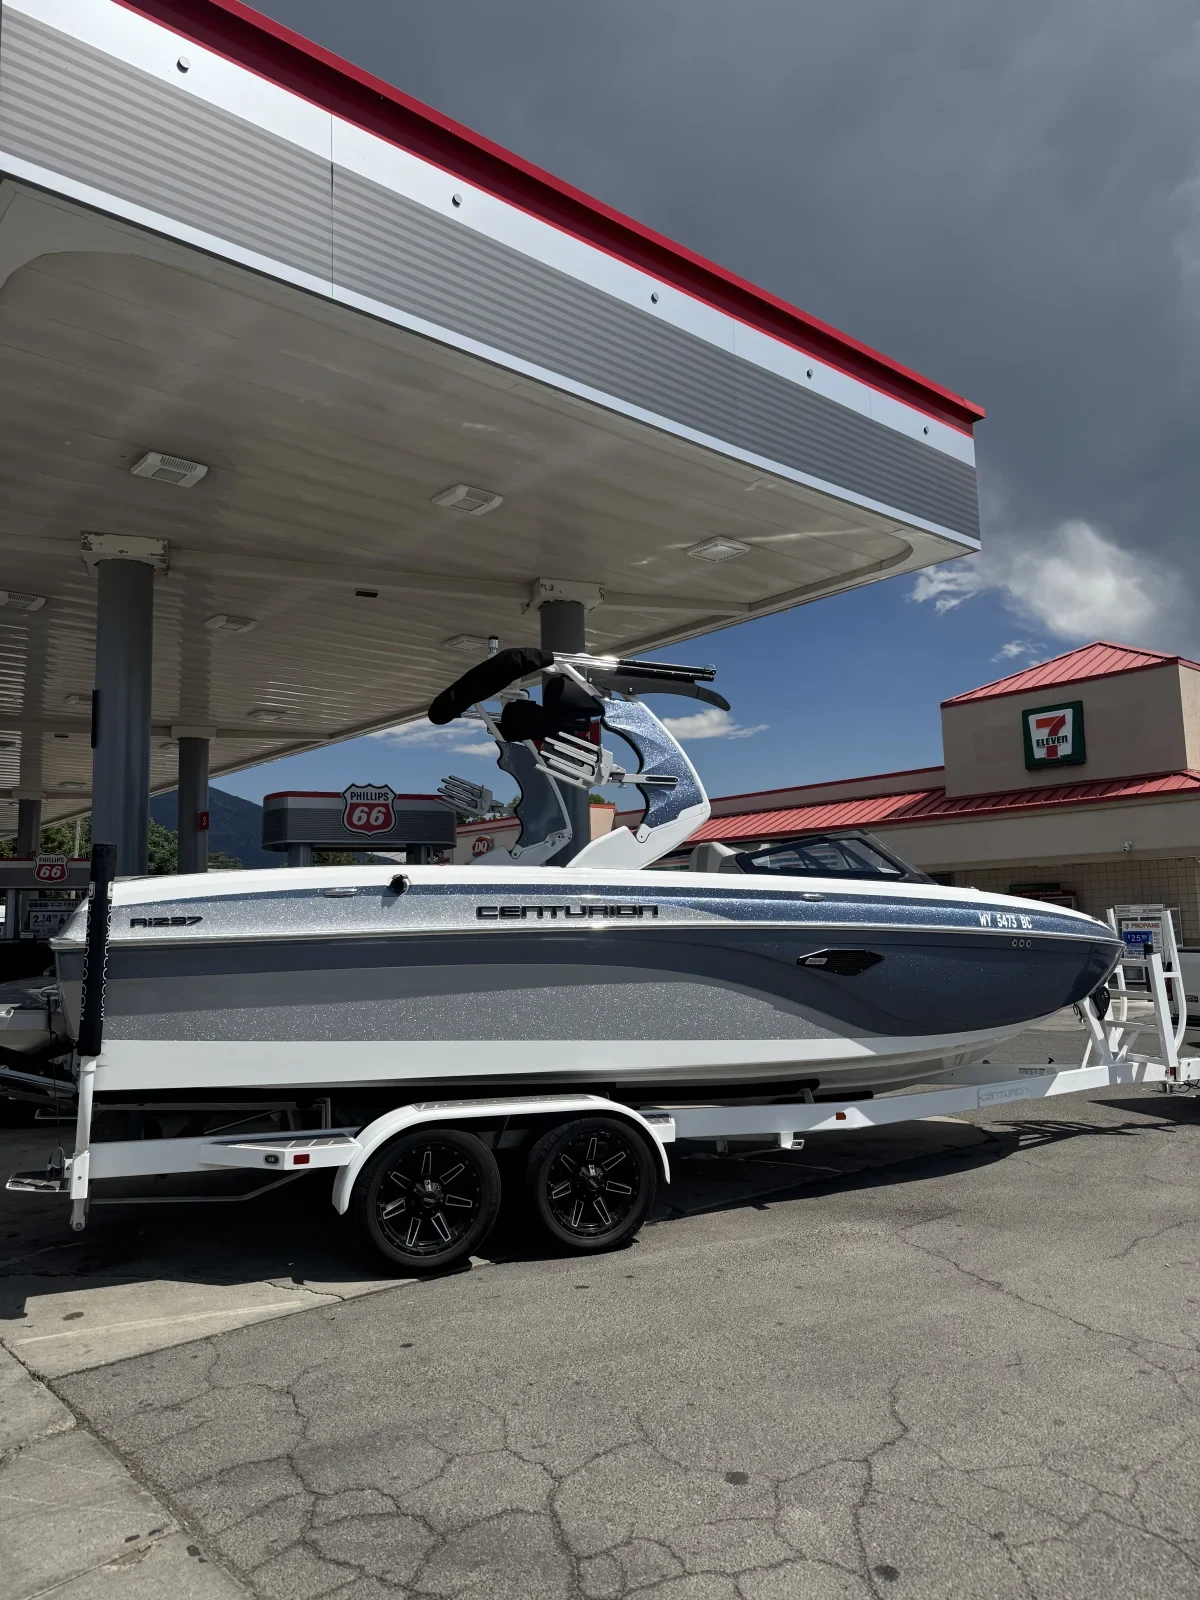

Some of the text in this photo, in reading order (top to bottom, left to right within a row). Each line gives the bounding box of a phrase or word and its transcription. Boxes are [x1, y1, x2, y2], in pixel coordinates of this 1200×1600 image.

[1035, 713, 1066, 758] 7
[350, 791, 389, 801] PHILLIPS
[202, 815, 207, 826] 3
[352, 806, 387, 826] 66
[474, 840, 488, 853] DQ
[38, 856, 65, 864] PHILLIPS
[39, 865, 62, 878] 66
[476, 904, 658, 919] CENTURION
[979, 913, 1032, 928] WY 5473 BC
